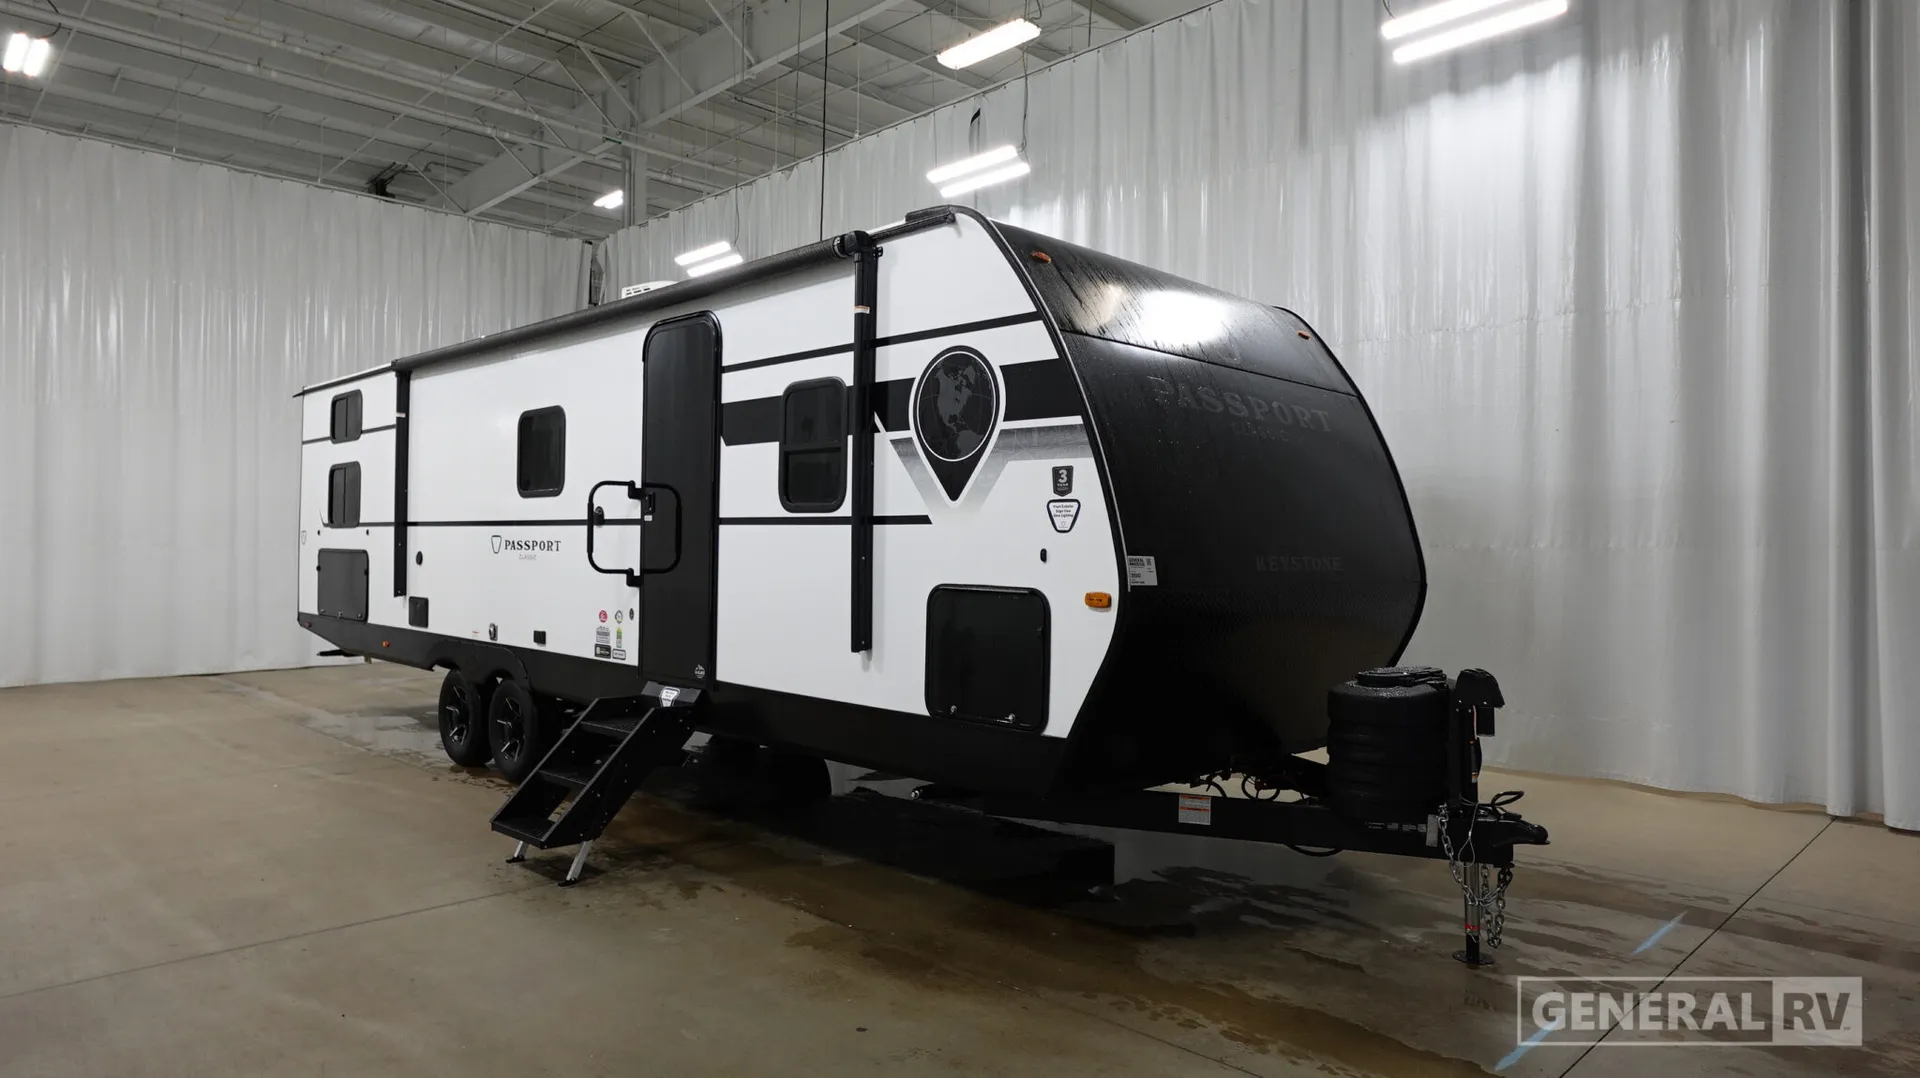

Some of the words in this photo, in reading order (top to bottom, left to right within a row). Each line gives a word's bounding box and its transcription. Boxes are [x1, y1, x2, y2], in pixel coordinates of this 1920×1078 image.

[1146, 373, 1332, 432] PASSPORT
[1059, 469, 1068, 483] 3
[504, 539, 562, 552] PASSPORT
[1255, 554, 1347, 572] KEYSTONE
